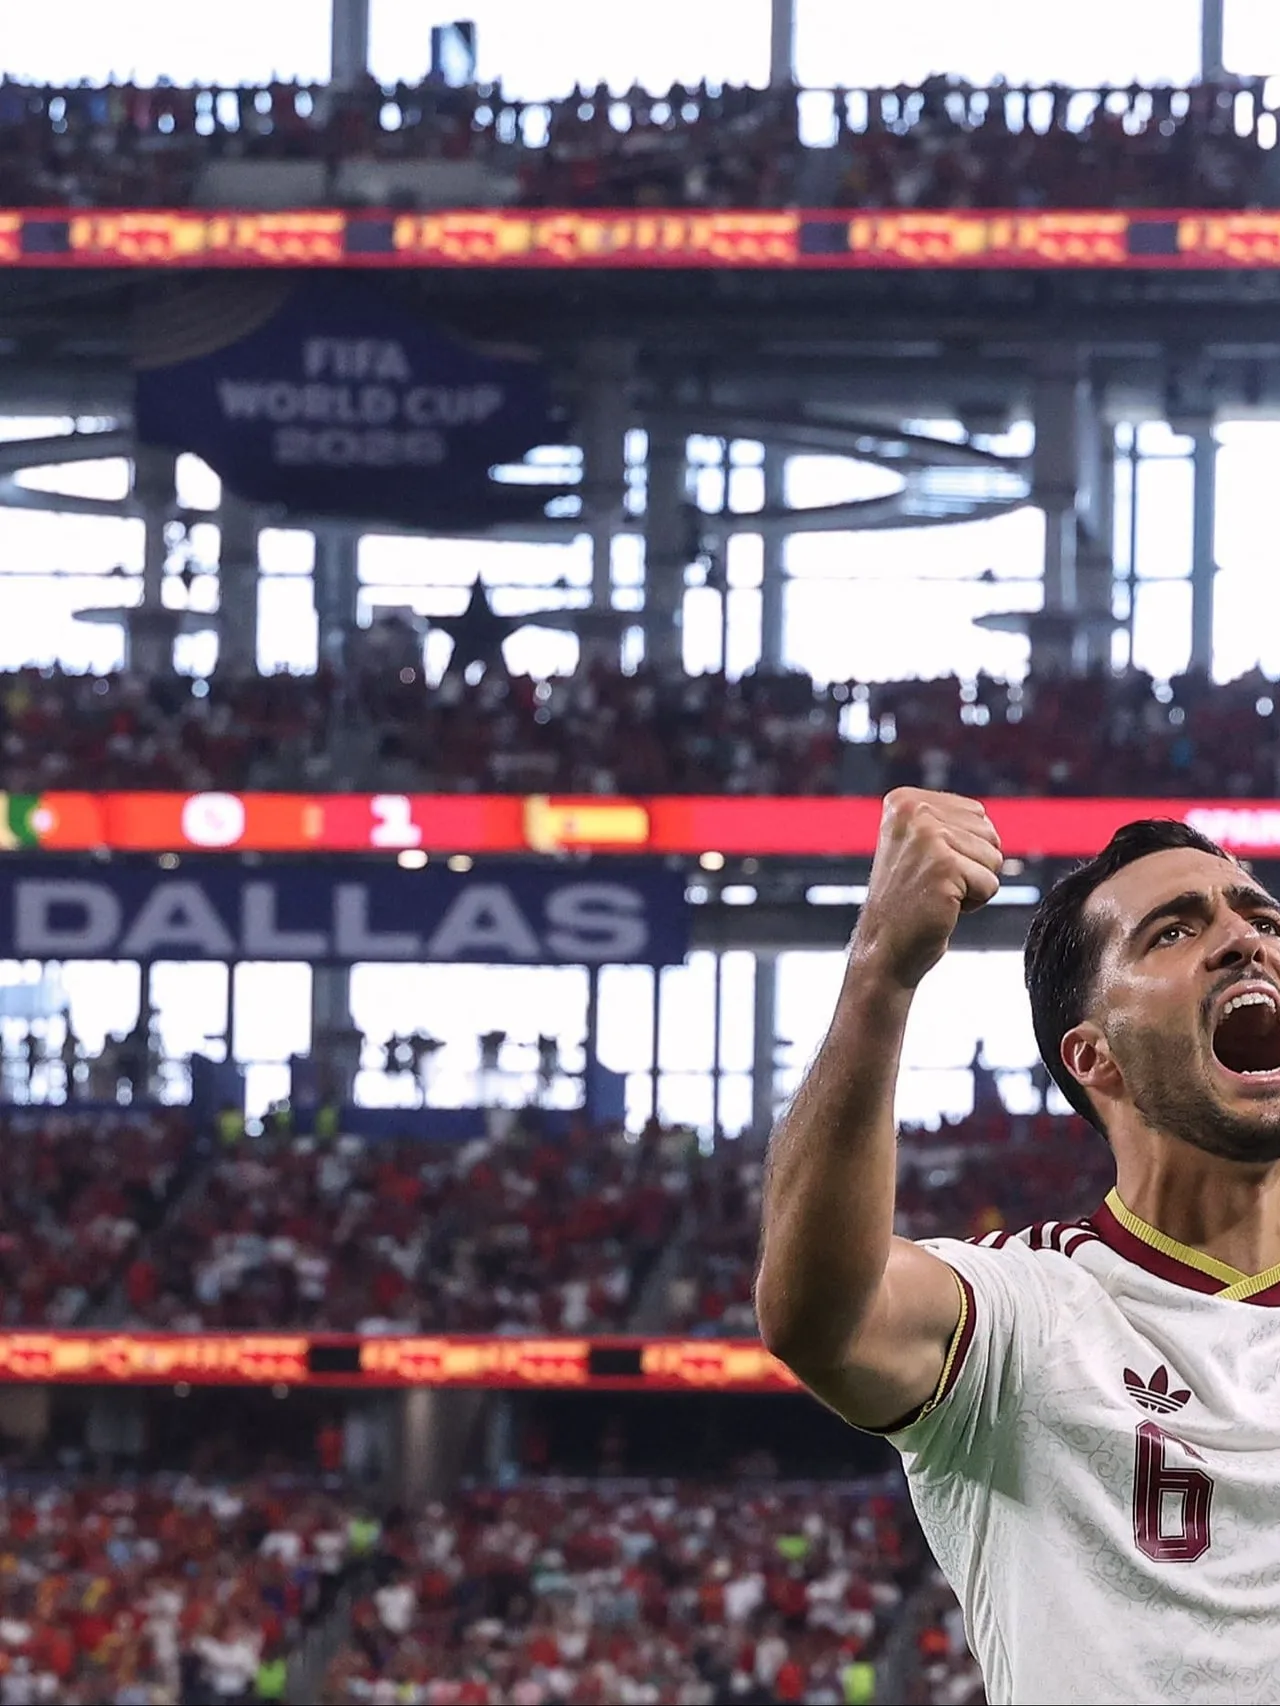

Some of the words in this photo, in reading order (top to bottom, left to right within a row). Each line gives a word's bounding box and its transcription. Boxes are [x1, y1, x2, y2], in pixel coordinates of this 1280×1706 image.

[303, 338, 410, 381] FIFA
[218, 379, 399, 423] WORLD
[404, 385, 504, 425] CUP
[274, 428, 446, 466] 2026
[14, 880, 650, 958] DALLAS
[1132, 1418, 1214, 1563] 6
